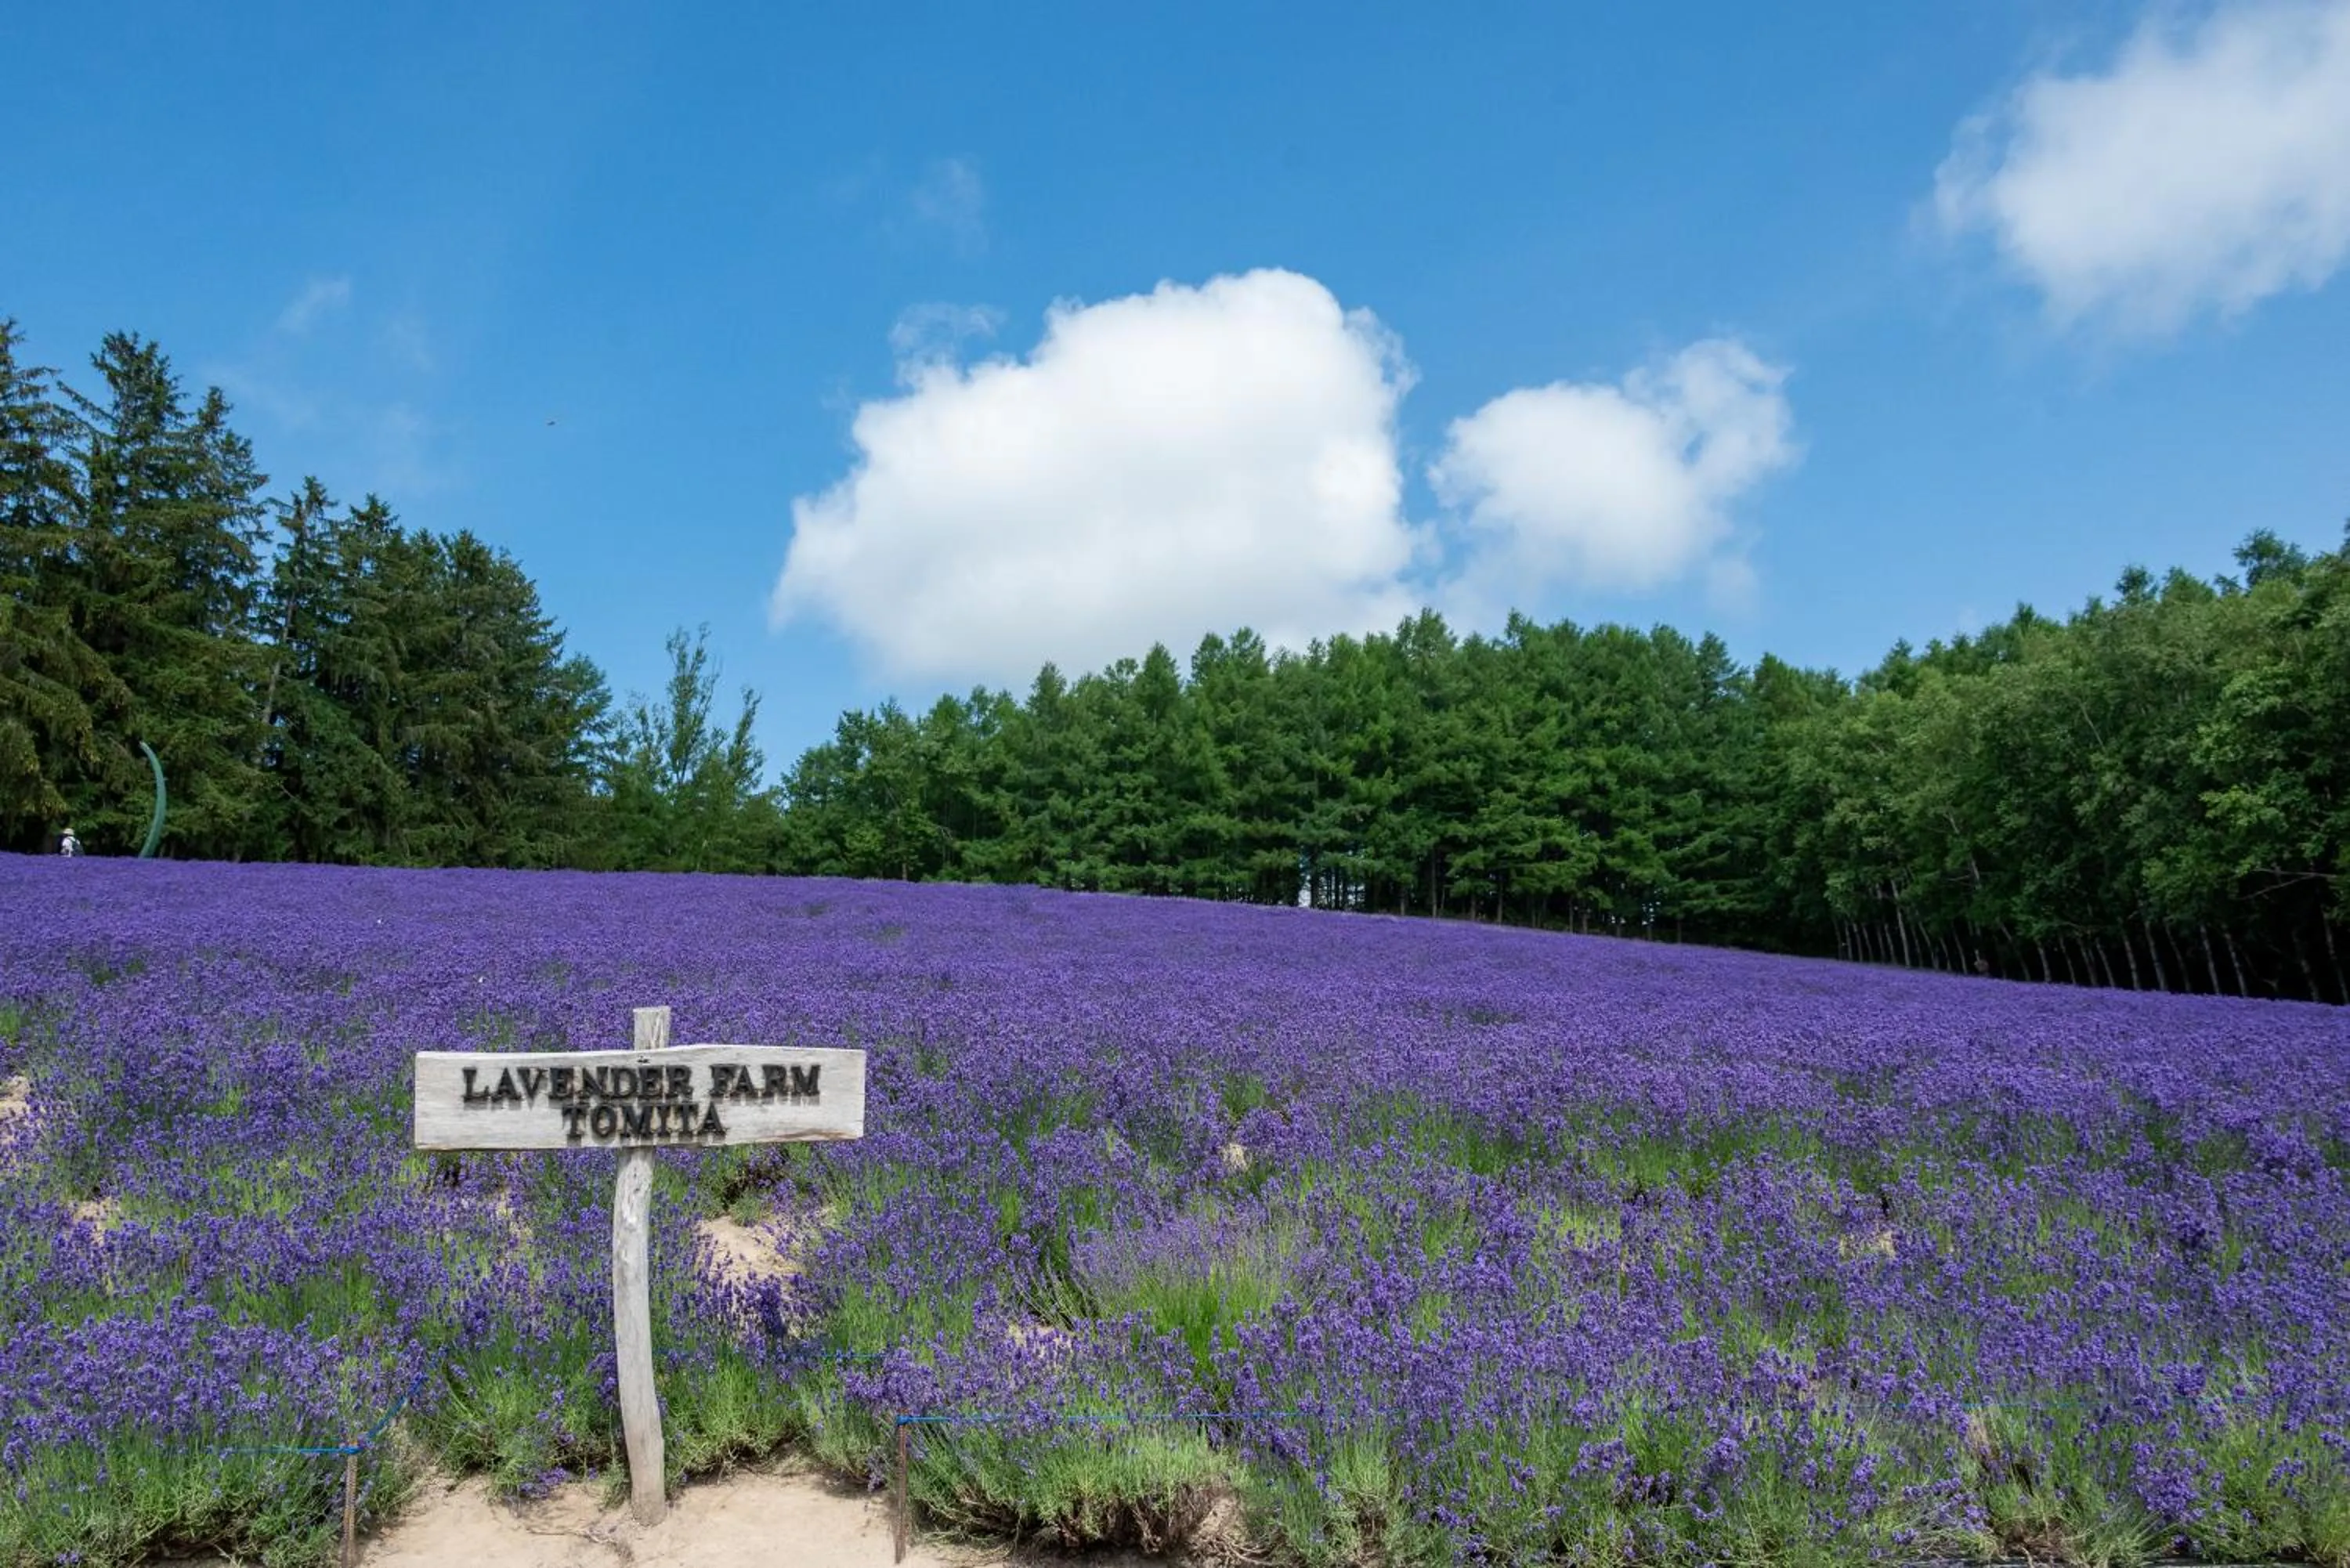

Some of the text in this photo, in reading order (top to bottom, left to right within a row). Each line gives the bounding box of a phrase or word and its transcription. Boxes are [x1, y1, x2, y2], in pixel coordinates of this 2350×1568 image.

[462, 1064, 821, 1103] LAVENDER FARM
[562, 1103, 726, 1139] TOMITA
